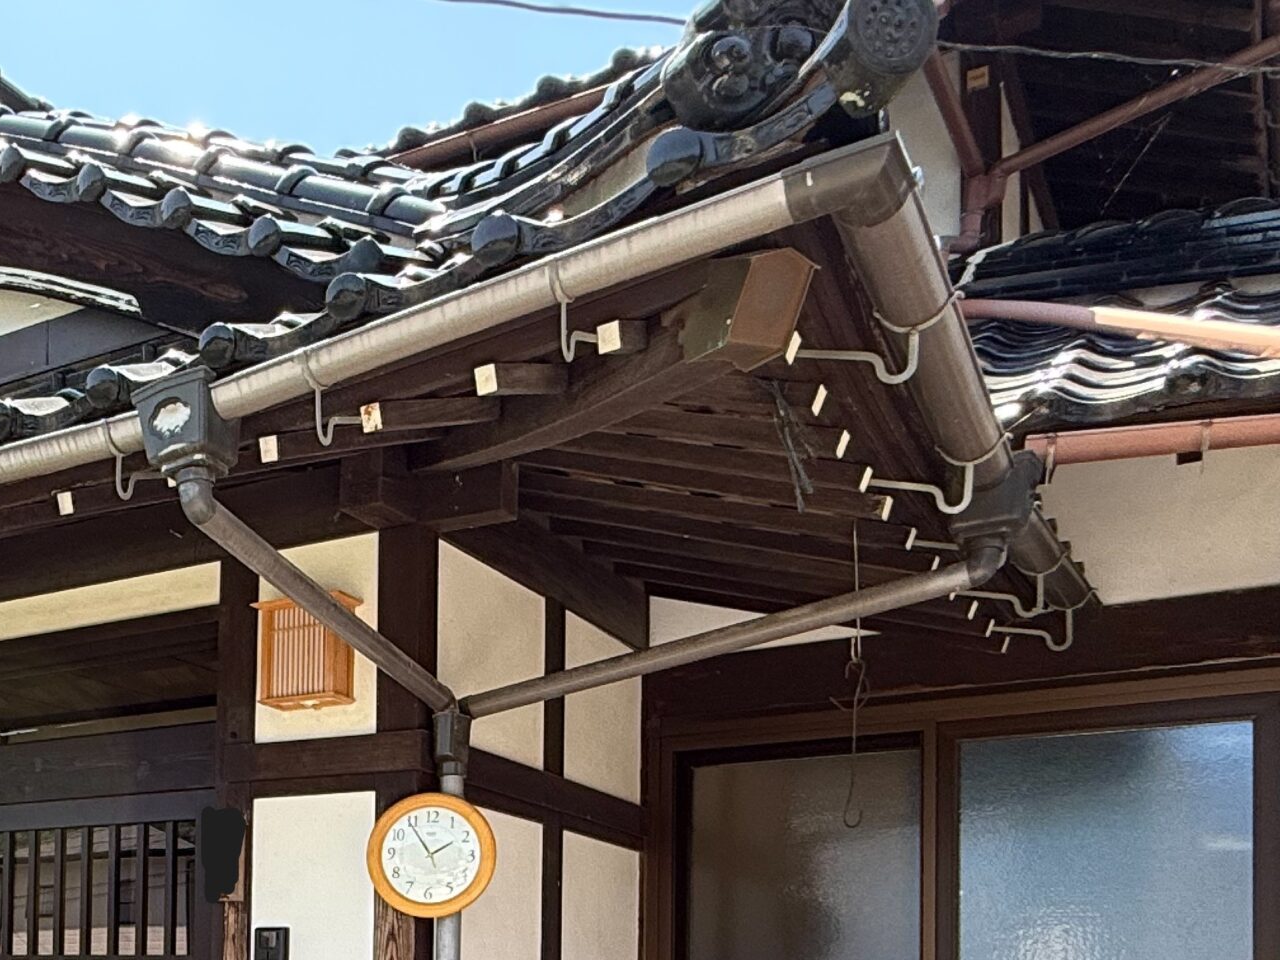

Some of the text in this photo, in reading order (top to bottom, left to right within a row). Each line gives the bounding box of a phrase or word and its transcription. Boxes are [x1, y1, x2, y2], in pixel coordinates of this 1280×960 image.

[408, 815, 418, 828] 11
[426, 811, 439, 823] 12
[392, 828, 405, 841] 10
[462, 830, 470, 843] 2
[388, 847, 396, 860] 9
[467, 850, 475, 863] 3
[392, 866, 400, 878] 8
[405, 881, 414, 894] 7
[424, 887, 432, 900] 6
[446, 882, 454, 894] 5
